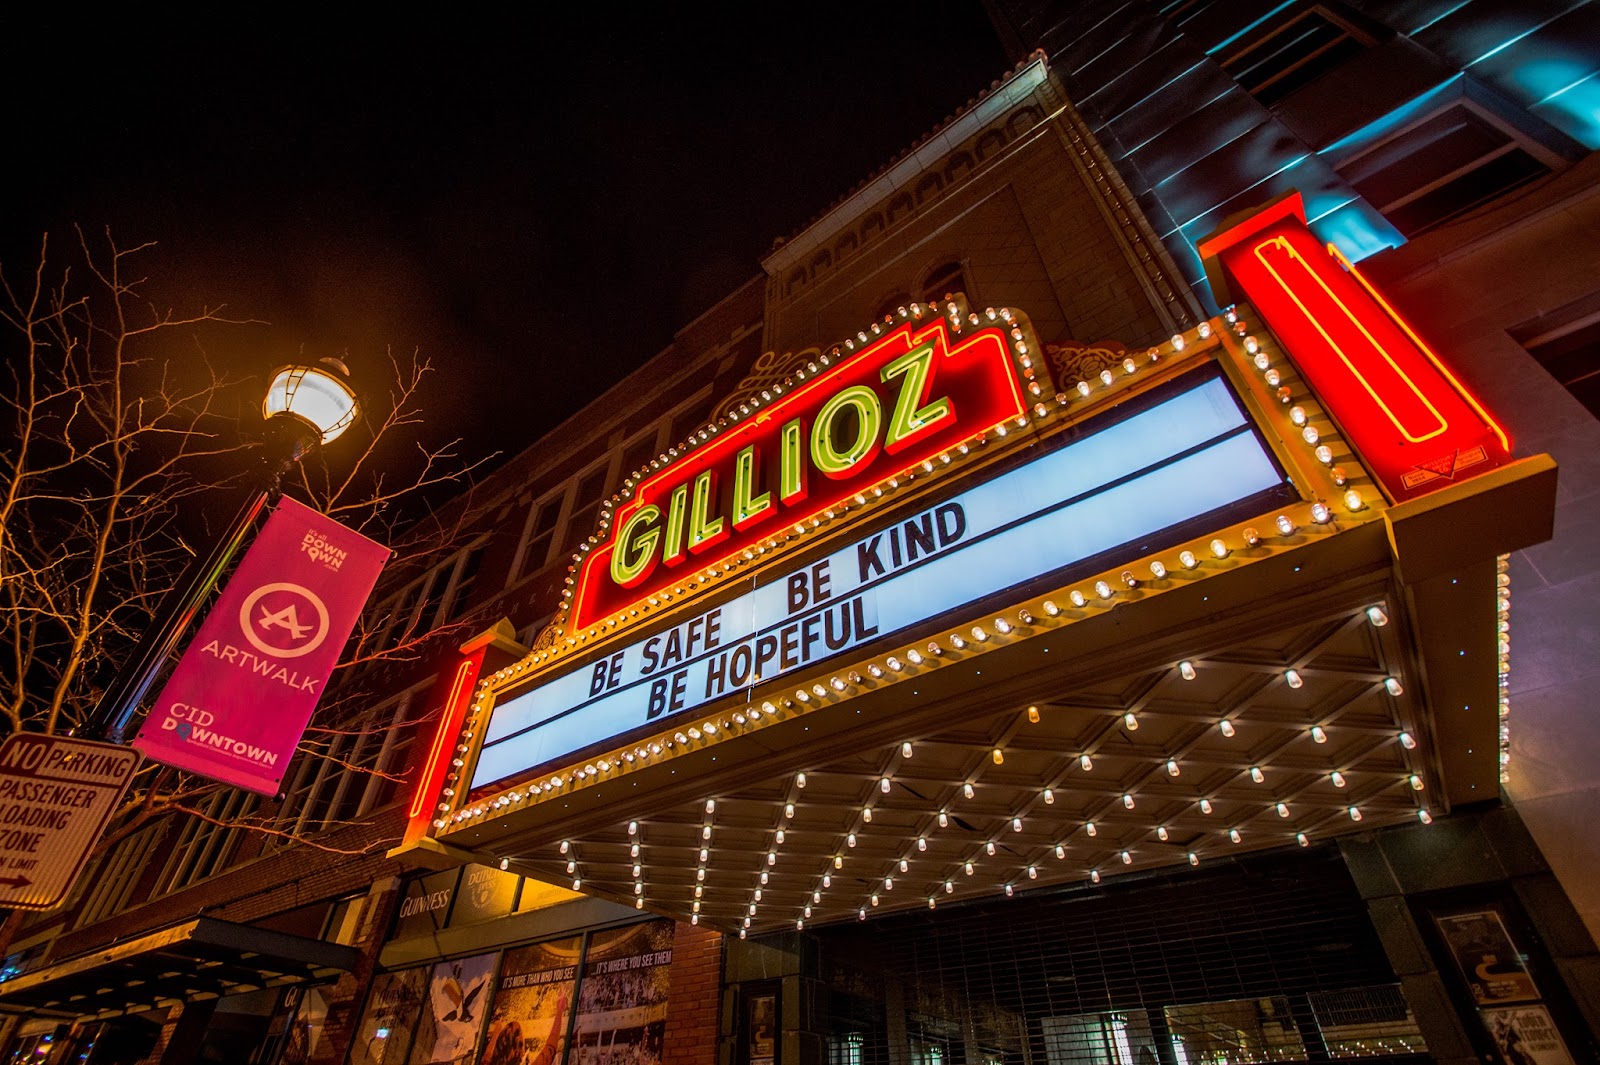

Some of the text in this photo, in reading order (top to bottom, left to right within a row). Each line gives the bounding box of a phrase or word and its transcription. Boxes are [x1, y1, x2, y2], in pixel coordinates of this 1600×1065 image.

[611, 335, 957, 588] GILLIOZ
[301, 542, 343, 569] TOWN
[303, 534, 347, 561] DOWN
[589, 502, 967, 698] BE SAFE BE KIND
[200, 640, 320, 694] ARTWALK
[646, 597, 879, 721] BE HOPEFUL
[170, 703, 214, 727] CID
[161, 717, 278, 766] DOWNTOWN
[1, 741, 130, 779] NO PARKING
[0, 780, 98, 809] PASSENGER
[8, 858, 40, 871] LIMIT
[400, 889, 450, 918] GUINNESS
[607, 957, 629, 973] WHERE
[629, 955, 642, 969] YOU
[641, 953, 654, 967] SEE
[654, 950, 672, 965] THEM
[502, 967, 575, 989] IT'S MORE THAN WHO YOU SEE
